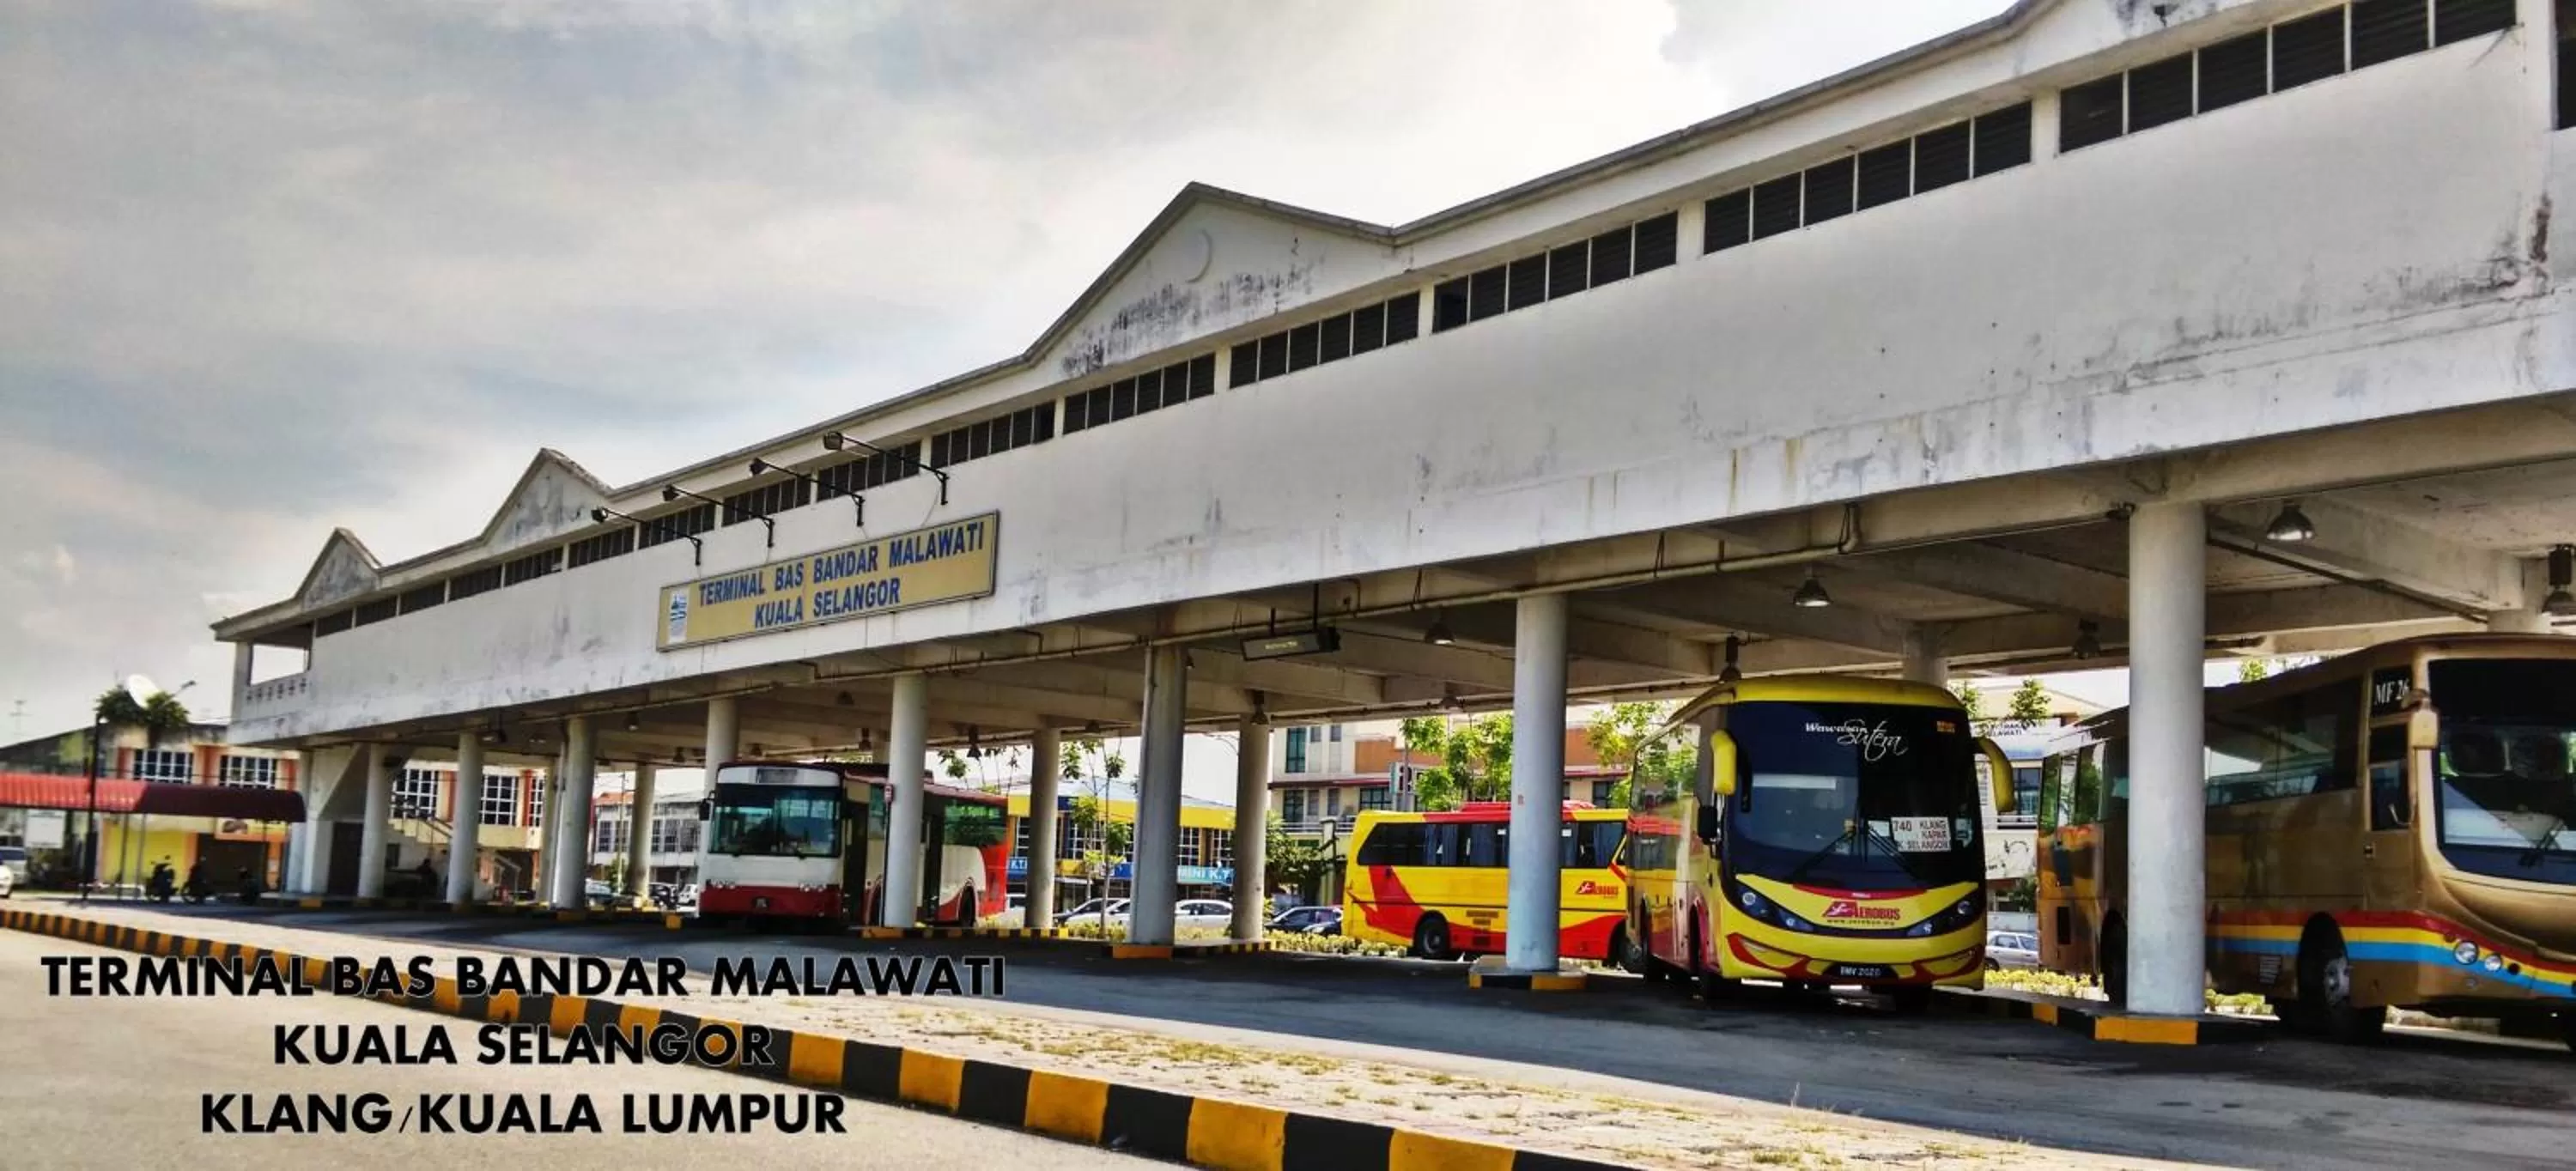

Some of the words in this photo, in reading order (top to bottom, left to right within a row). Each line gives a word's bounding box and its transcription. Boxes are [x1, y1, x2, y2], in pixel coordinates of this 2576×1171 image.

[699, 572, 765, 607] TERMINAL
[775, 562, 804, 591] BAS
[813, 545, 878, 584] BANDAR
[889, 522, 983, 568] MALAWATI
[755, 596, 804, 628] KUALA
[813, 579, 901, 616] SELANGOR
[2374, 682, 2396, 705] MF
[1893, 820, 1912, 831] 740
